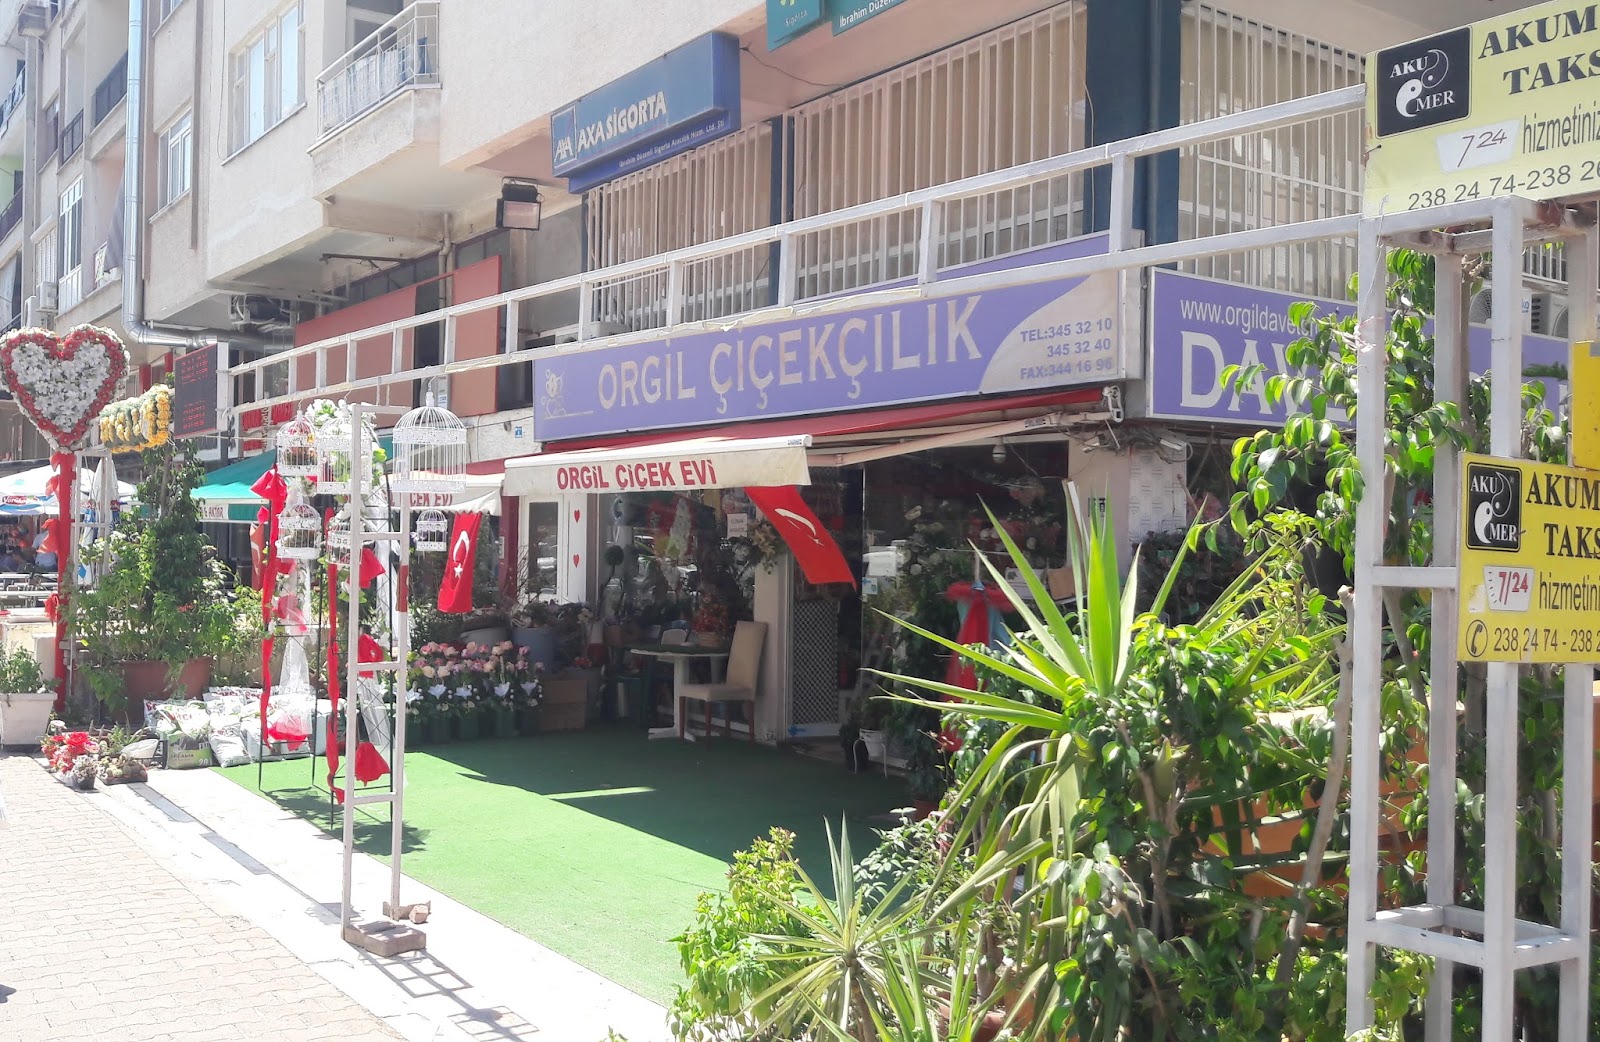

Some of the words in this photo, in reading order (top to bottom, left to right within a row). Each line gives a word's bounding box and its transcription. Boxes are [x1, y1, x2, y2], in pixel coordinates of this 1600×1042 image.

[1478, 4, 1599, 60] AKUM
[1390, 55, 1428, 79] AKU
[1414, 89, 1456, 112] MER
[1408, 187, 1446, 211] 238
[1454, 181, 1480, 203] 24
[1020, 323, 1071, 342] TEL:345
[1075, 320, 1092, 335] 32
[1096, 317, 1112, 331] 10
[1047, 343, 1070, 358] 345
[1074, 340, 1090, 354] 32
[1094, 338, 1111, 351] 40
[598, 338, 696, 410] ORGİL
[1076, 360, 1092, 373] 16
[557, 465, 609, 490] ORGİL
[615, 461, 676, 491] ÇİÇEK
[680, 459, 717, 486] EVİ
[1470, 475, 1498, 494] AKU
[1488, 523, 1518, 542] MER
[1498, 571, 1529, 606] 7/24
[1494, 627, 1518, 652] 238
[1523, 627, 1539, 652] 24
[1543, 628, 1558, 652] 74
[1570, 629, 1593, 653] 238
